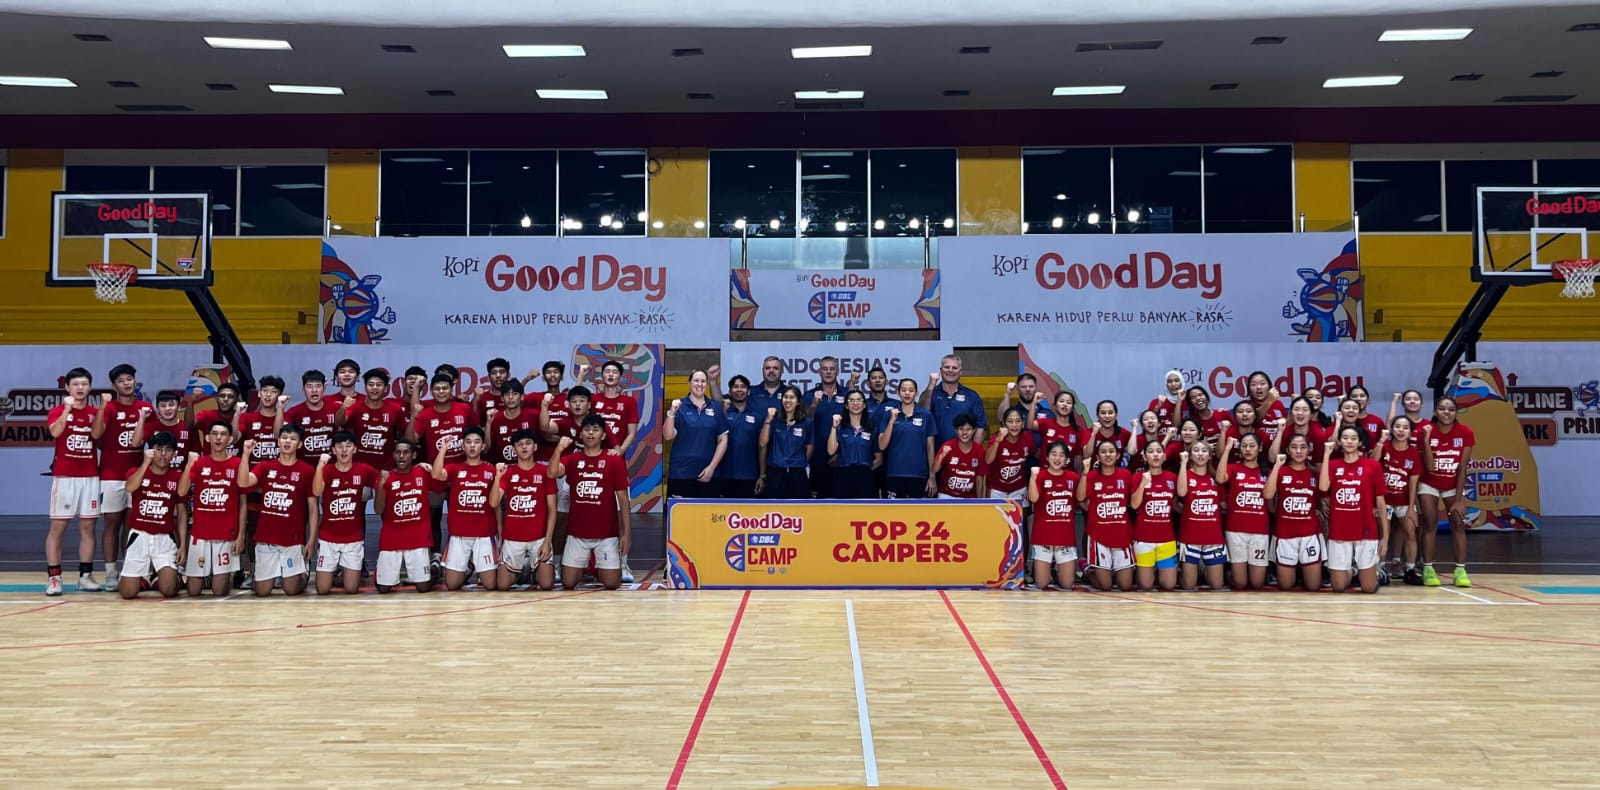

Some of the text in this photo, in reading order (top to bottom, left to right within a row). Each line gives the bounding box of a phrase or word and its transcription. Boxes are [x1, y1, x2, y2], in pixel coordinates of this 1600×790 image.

[98, 202, 176, 222] Good Day
[1574, 196, 1600, 214] Da
[485, 254, 586, 292] Good
[592, 254, 667, 302] Day
[811, 274, 847, 288] Good
[849, 274, 876, 291] Day
[1035, 252, 1139, 290] Good
[1144, 251, 1223, 299] Day
[828, 303, 871, 318] CAMP
[997, 311, 1225, 323] KARENA HIDUP PERLU BANYAK RASA
[444, 313, 667, 325] KARENA HIDUP PERLU BANYAK RASA
[782, 358, 901, 374] NDOESIA'S
[1209, 367, 1294, 399] God
[1495, 457, 1519, 471] Day
[1478, 483, 1516, 496] CAMP
[728, 513, 769, 529] Good
[772, 513, 802, 533] Day
[850, 521, 950, 541] TOP 24
[217, 552, 230, 567] 13
[748, 548, 797, 565] CAMP
[833, 543, 969, 563] CAMPERS
[1254, 550, 1265, 560] 22
[1306, 546, 1317, 557] 16
[317, 556, 325, 567] 8
